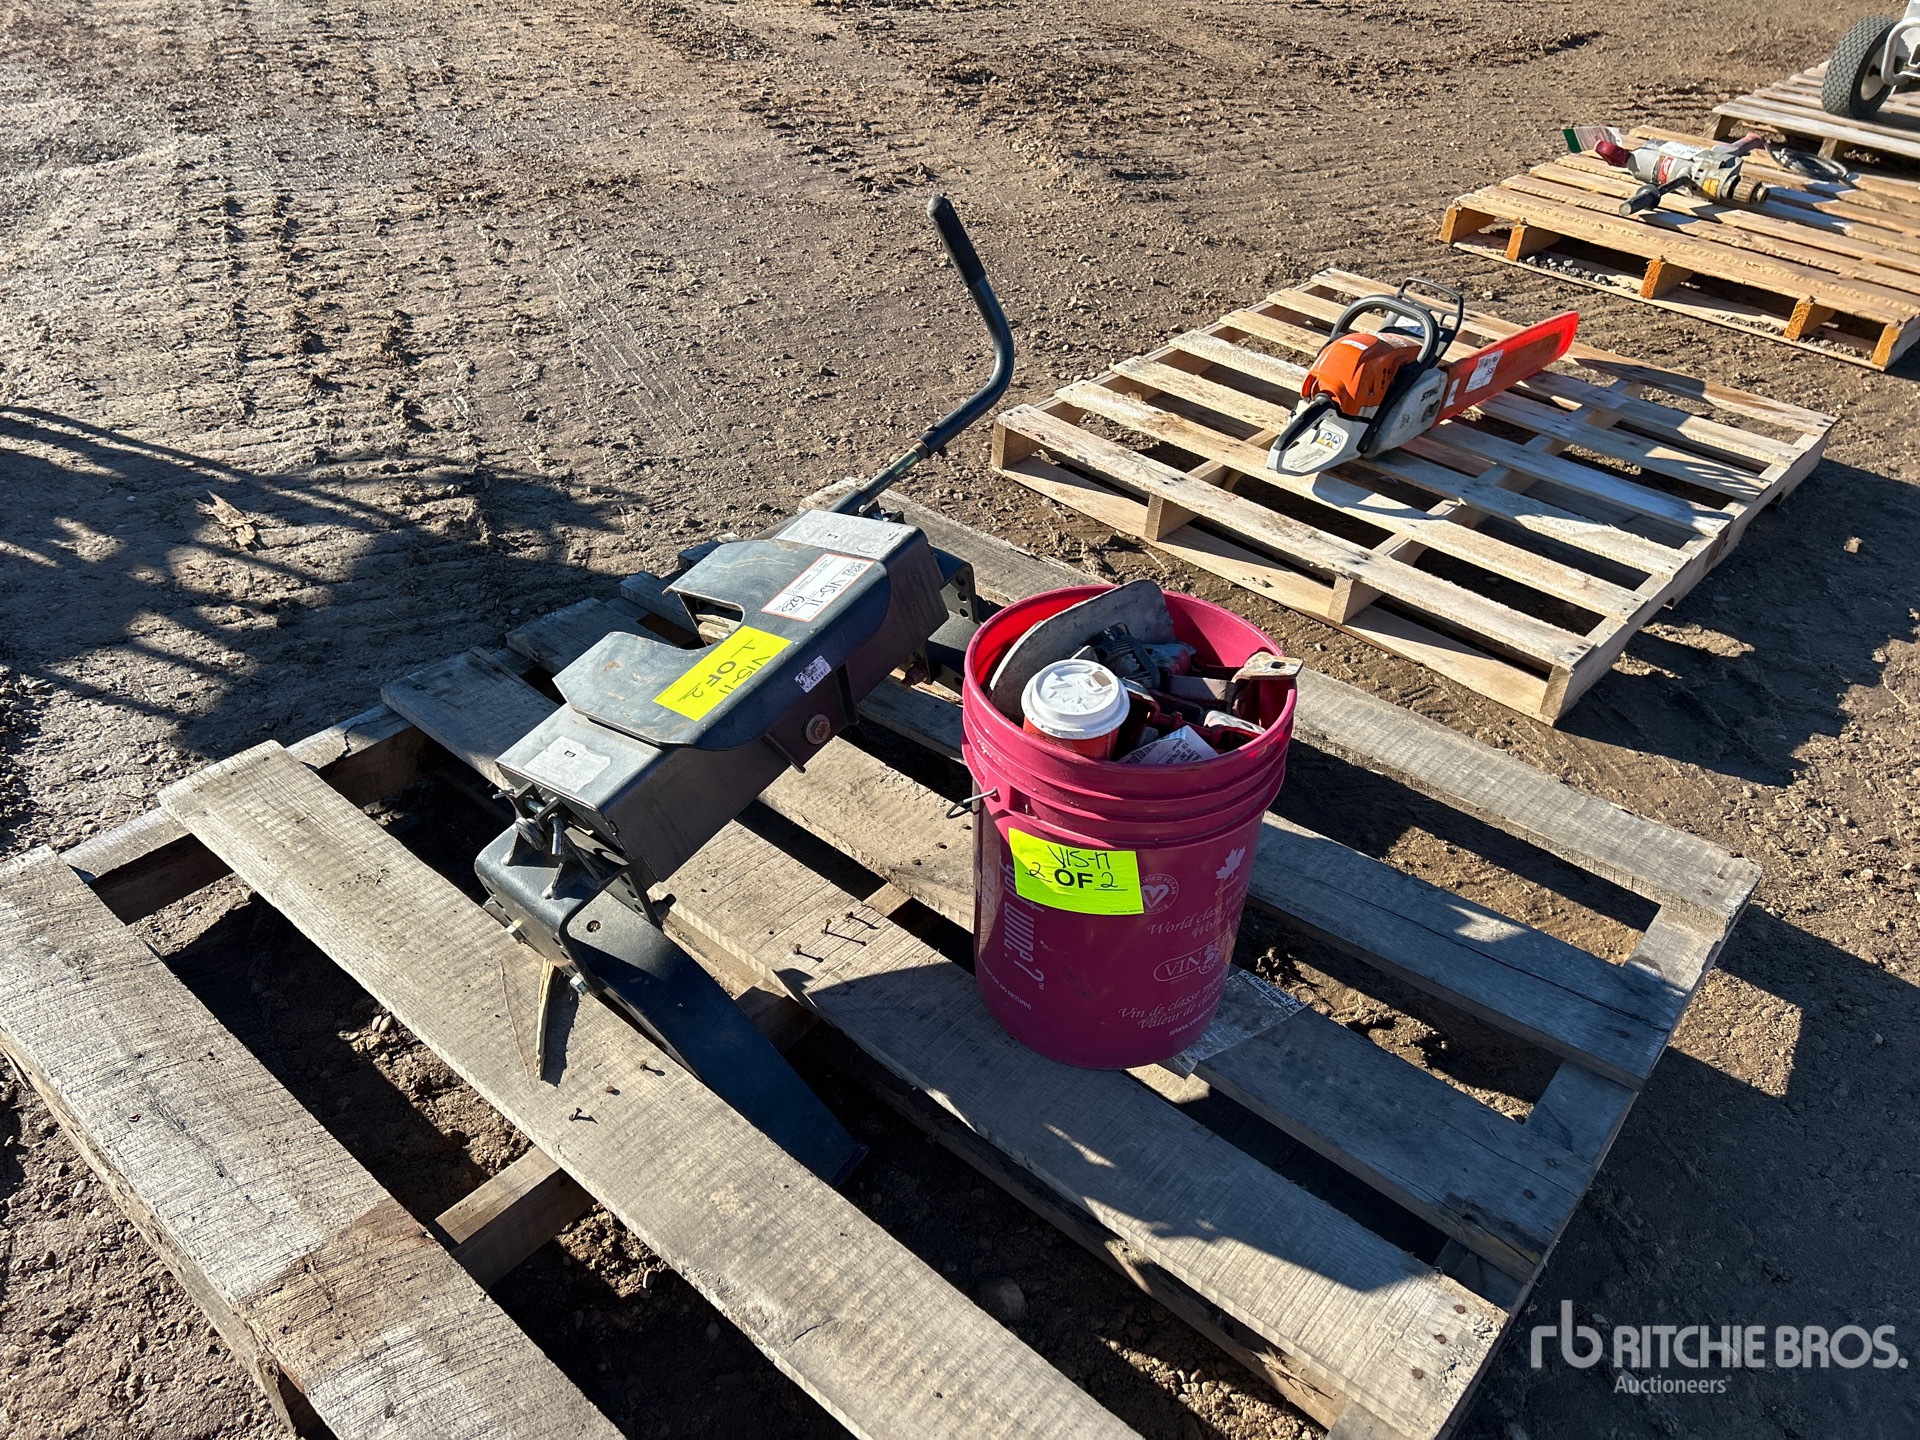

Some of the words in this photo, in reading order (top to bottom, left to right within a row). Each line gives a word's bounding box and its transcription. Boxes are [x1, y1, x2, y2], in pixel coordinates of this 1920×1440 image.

[706, 661, 737, 687] OF
[683, 687, 704, 701] 2
[1028, 861, 1048, 879] 2
[1054, 868, 1093, 889] OF
[1101, 872, 1118, 889] 2
[1147, 912, 1198, 935] World
[1164, 951, 1203, 977] VIN
[1118, 1007, 1146, 1019] Vin
[1149, 1003, 1165, 1017] de
